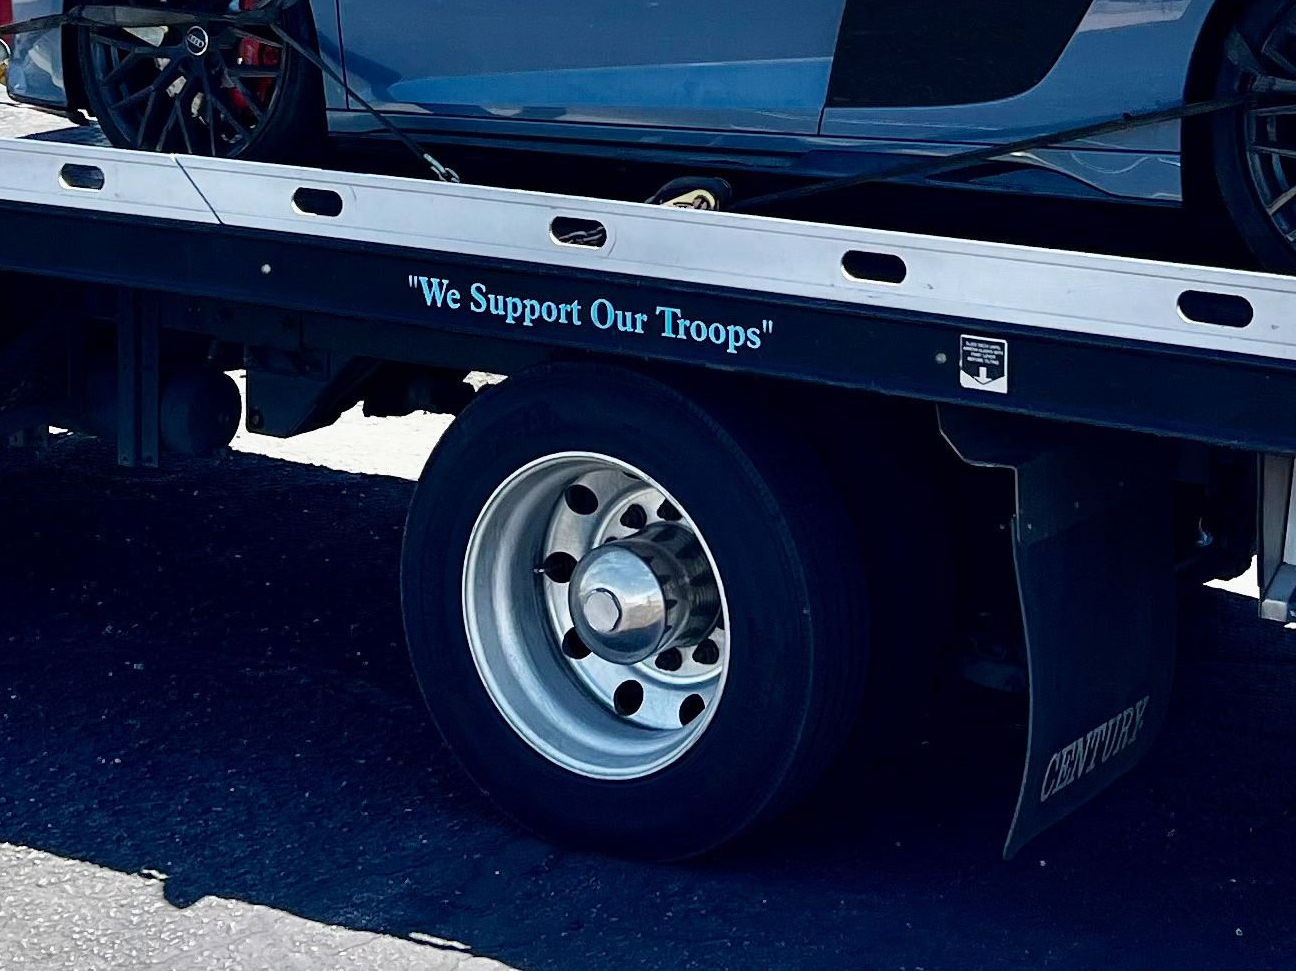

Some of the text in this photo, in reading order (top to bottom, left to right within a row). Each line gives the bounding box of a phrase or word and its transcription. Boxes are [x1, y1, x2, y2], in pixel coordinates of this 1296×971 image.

[408, 274, 774, 354] "We Support Our Troops"
[1041, 695, 1150, 802] CENTURY
